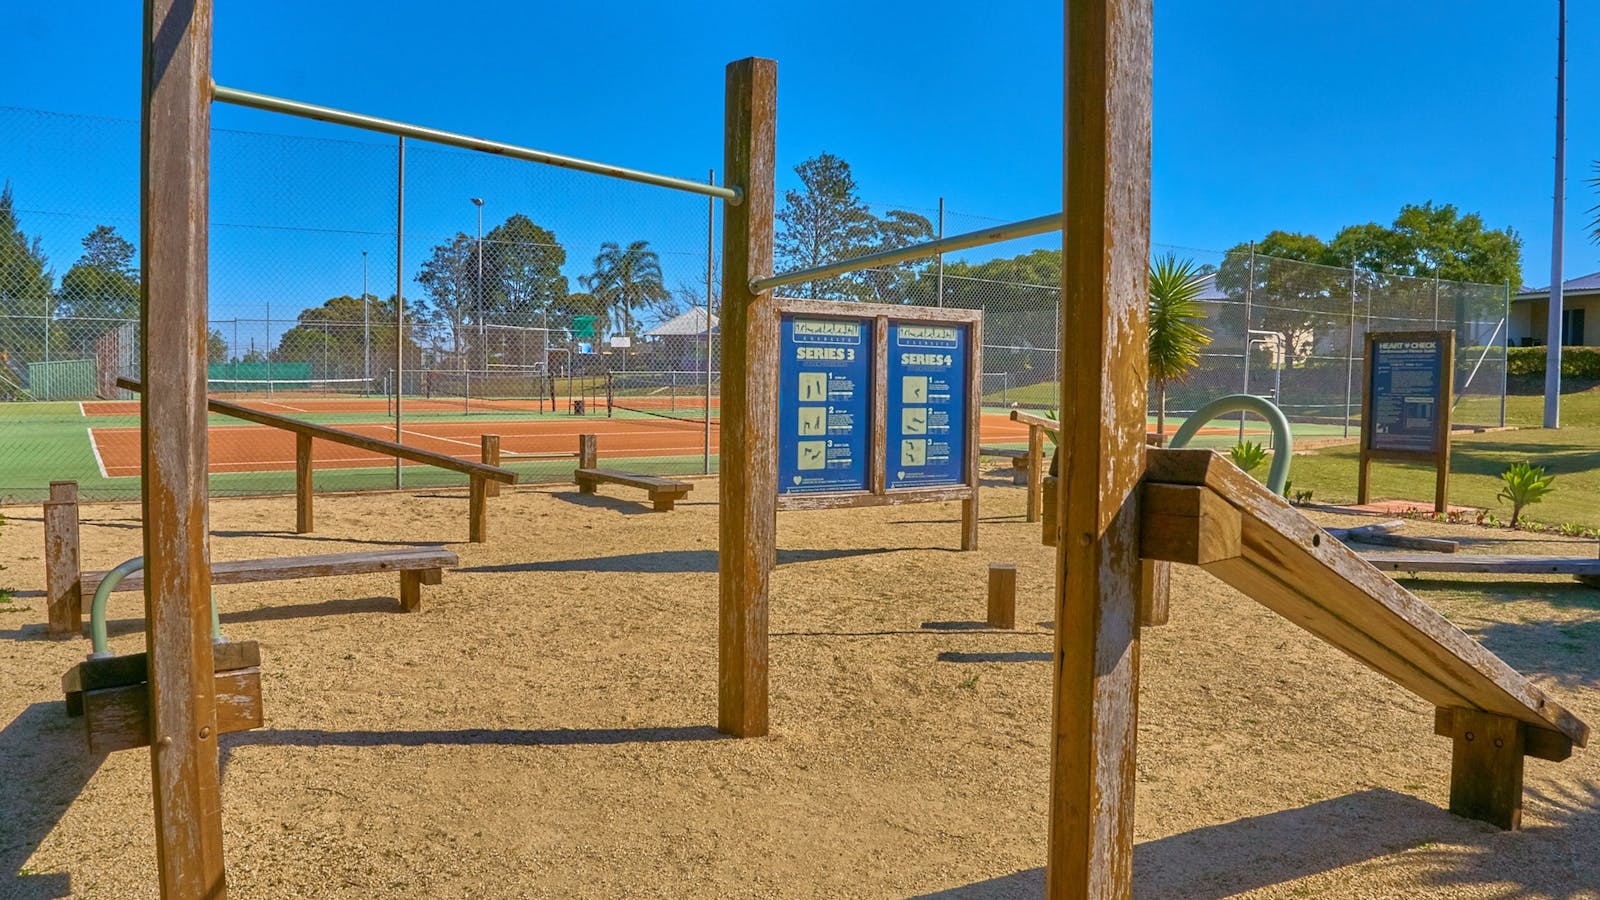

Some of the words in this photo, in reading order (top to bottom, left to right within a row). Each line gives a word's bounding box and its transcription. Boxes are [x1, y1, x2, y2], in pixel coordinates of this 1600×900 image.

[797, 347, 845, 360] SERIES
[847, 349, 855, 360] 3
[901, 353, 944, 366] SERIES
[944, 355, 953, 366] 4
[828, 406, 834, 414] 2
